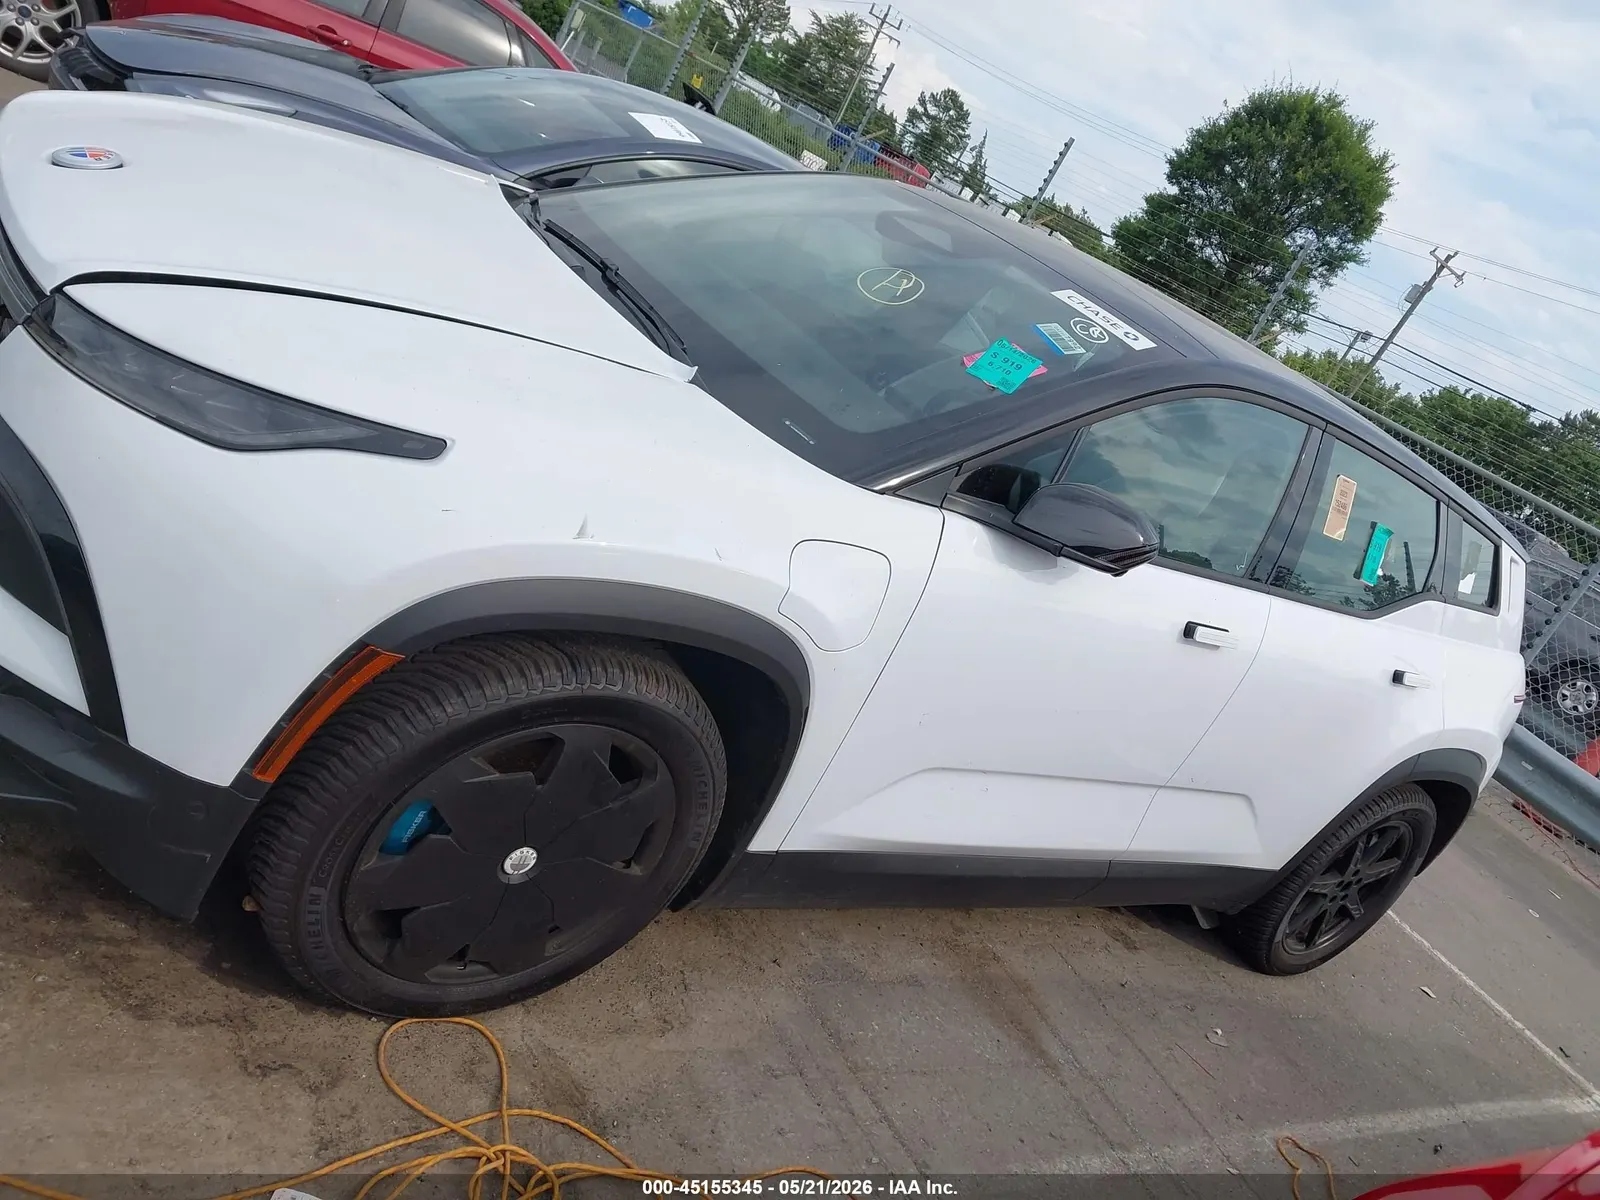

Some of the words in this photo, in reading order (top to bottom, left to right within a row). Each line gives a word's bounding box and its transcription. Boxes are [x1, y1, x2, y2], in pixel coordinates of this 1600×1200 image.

[1067, 295, 1125, 330] CHASE
[990, 351, 1000, 359] S
[1001, 357, 1023, 371] 919
[402, 811, 427, 842] FISKER
[307, 892, 342, 979] MICHELIN
